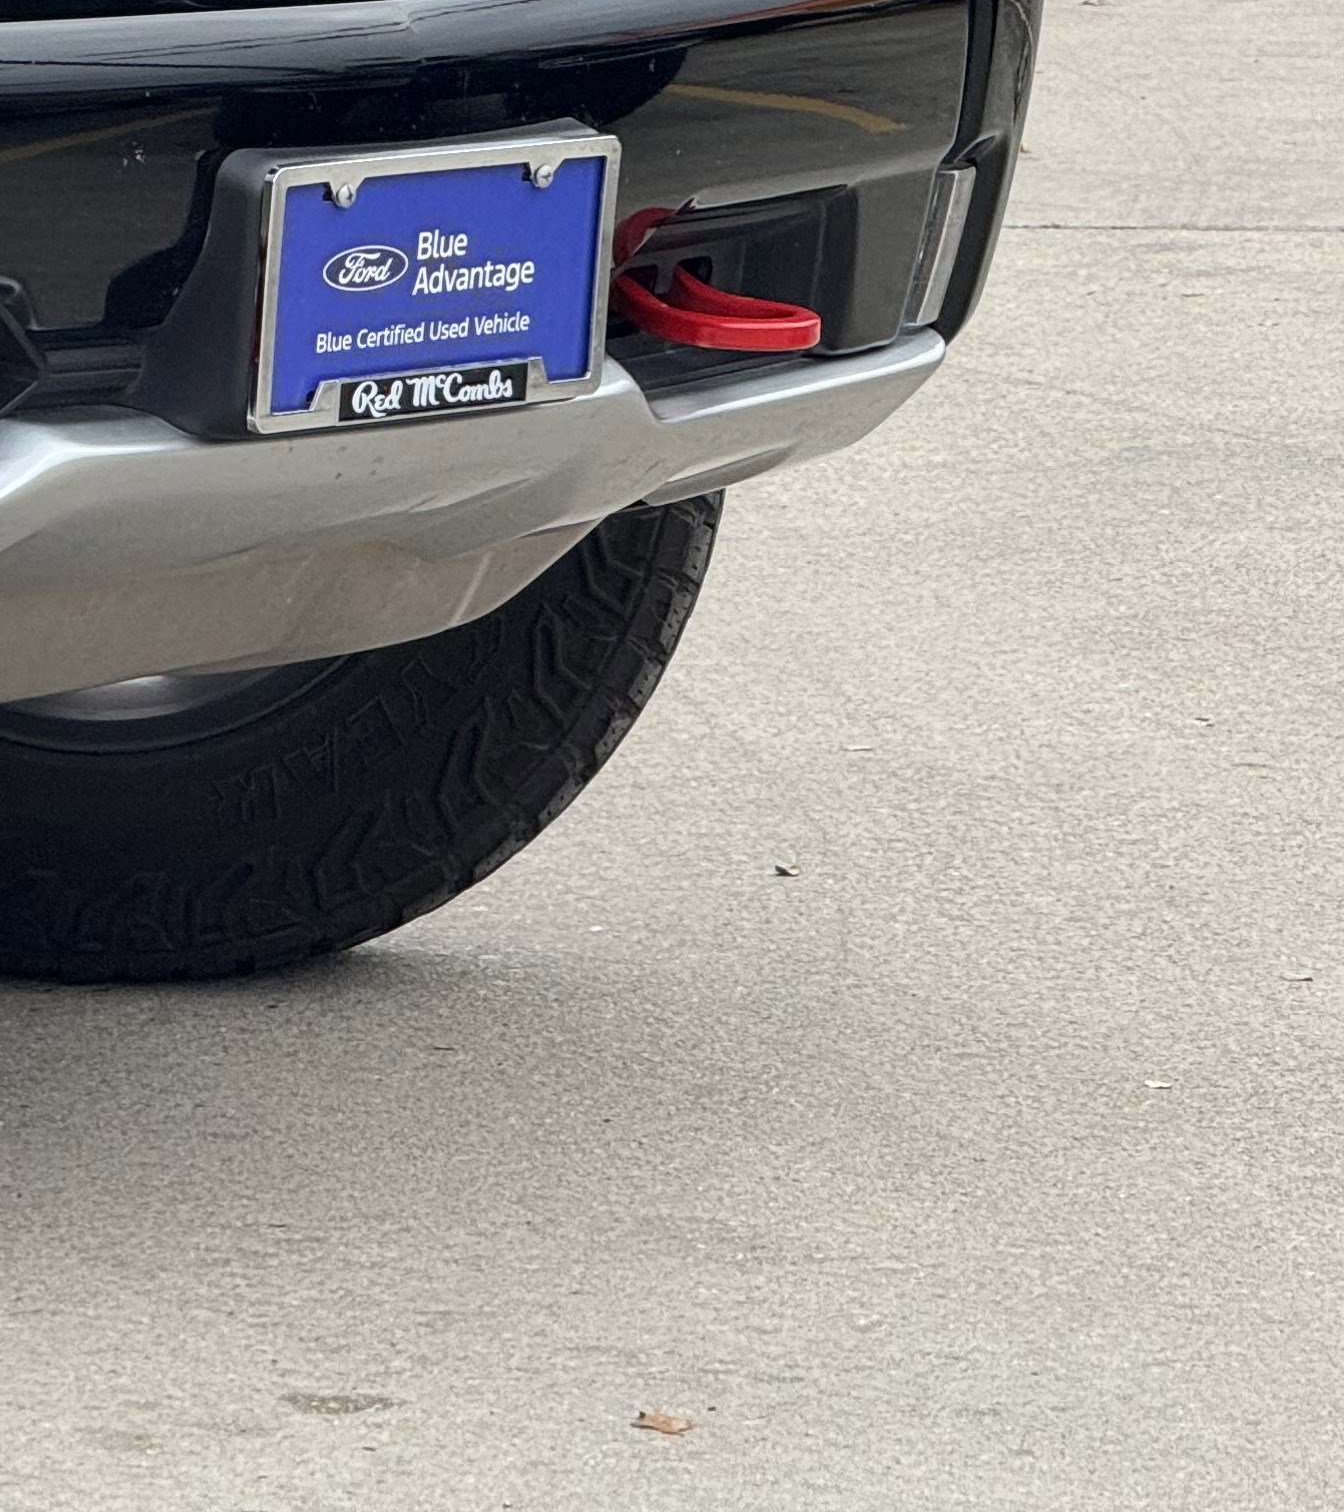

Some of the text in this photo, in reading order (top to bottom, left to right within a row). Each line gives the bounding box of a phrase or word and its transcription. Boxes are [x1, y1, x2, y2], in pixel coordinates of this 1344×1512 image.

[416, 229, 469, 261] Blue
[338, 251, 393, 285] Ford
[412, 260, 535, 296] Advantage
[315, 311, 531, 354] Blue Certified Used Vehicle
[351, 369, 513, 418] Red McCombs
